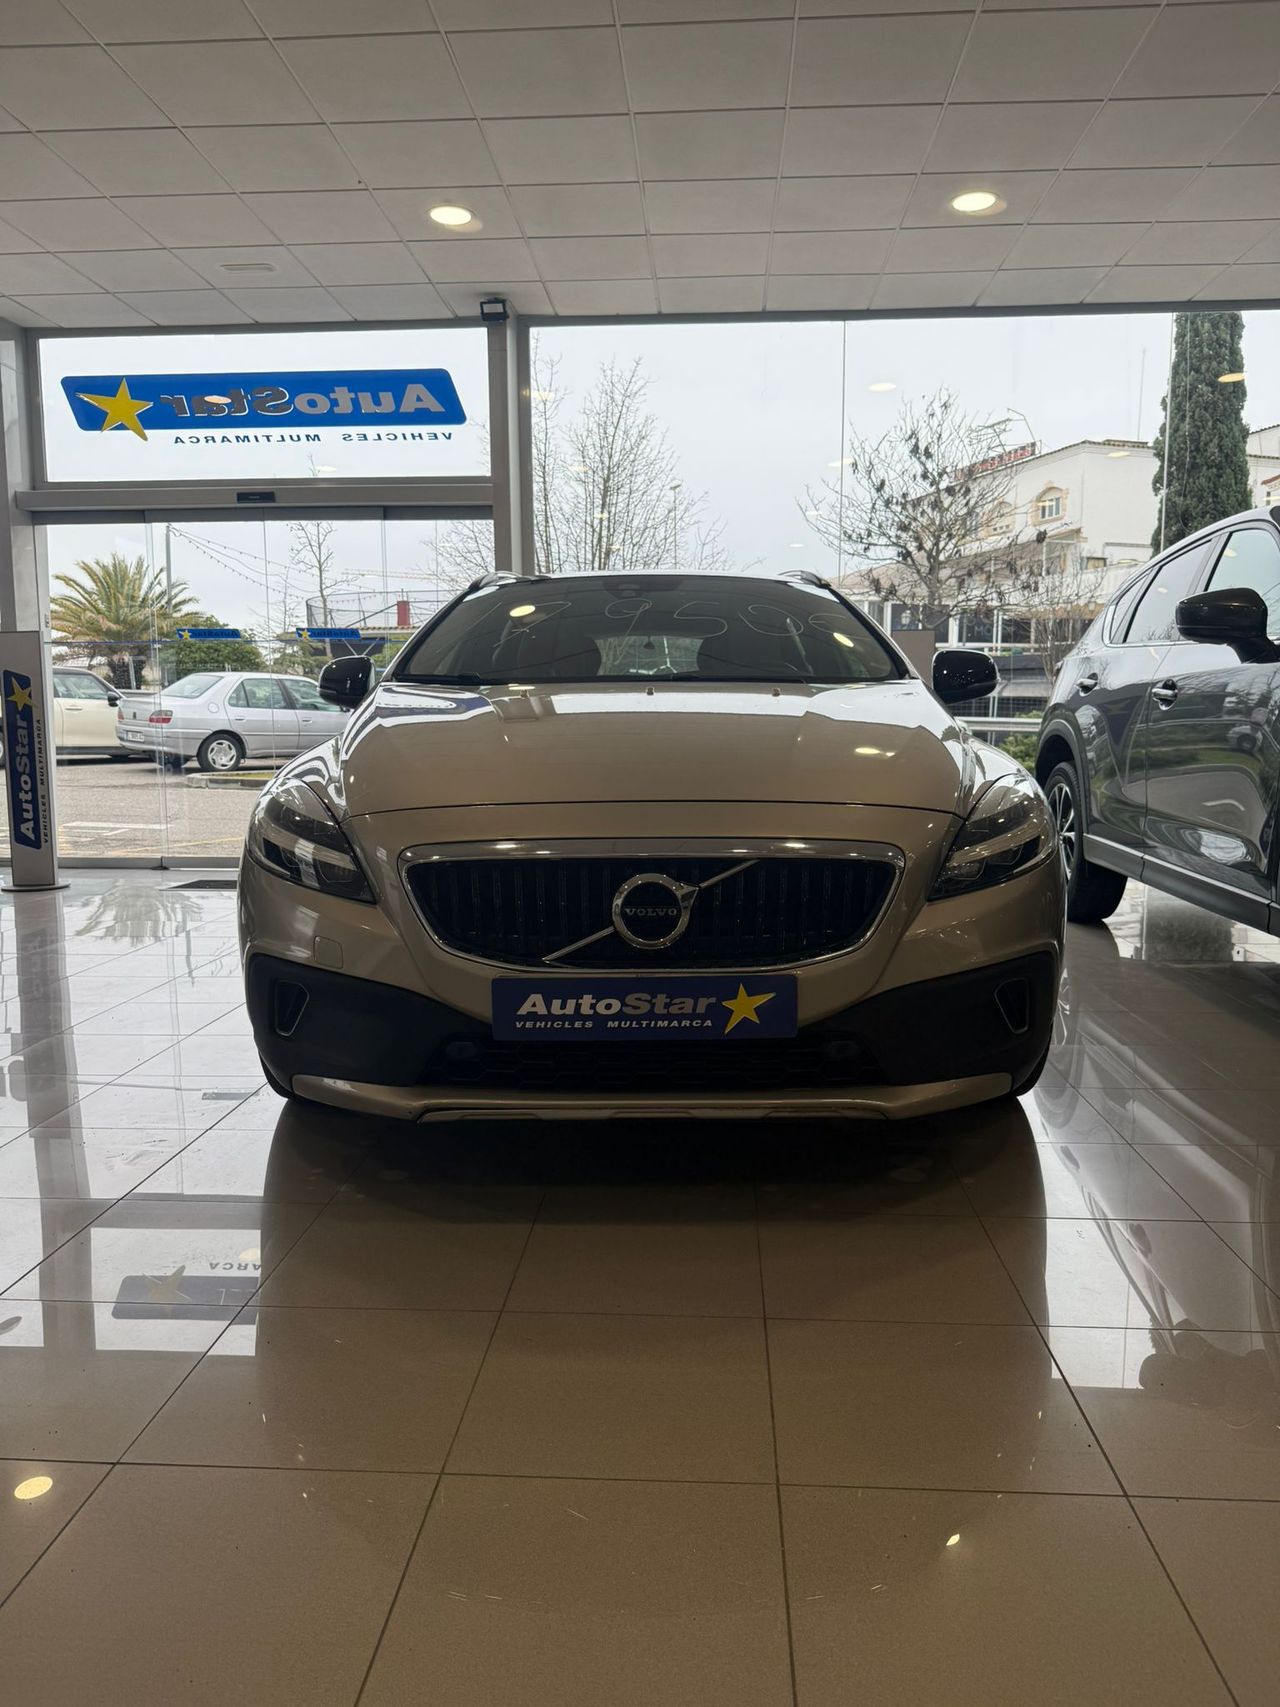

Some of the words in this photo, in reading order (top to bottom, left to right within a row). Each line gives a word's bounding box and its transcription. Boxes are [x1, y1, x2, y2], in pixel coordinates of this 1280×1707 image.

[35, 719, 46, 786] MULTIMARCA
[16, 714, 35, 841] AutoStar
[40, 795, 49, 844] VEHICLES
[624, 907, 678, 917] VOLVO
[515, 992, 717, 1016] AutoStar
[515, 1020, 594, 1029] VEHICLES
[606, 1018, 714, 1029] MULTIMARCA
